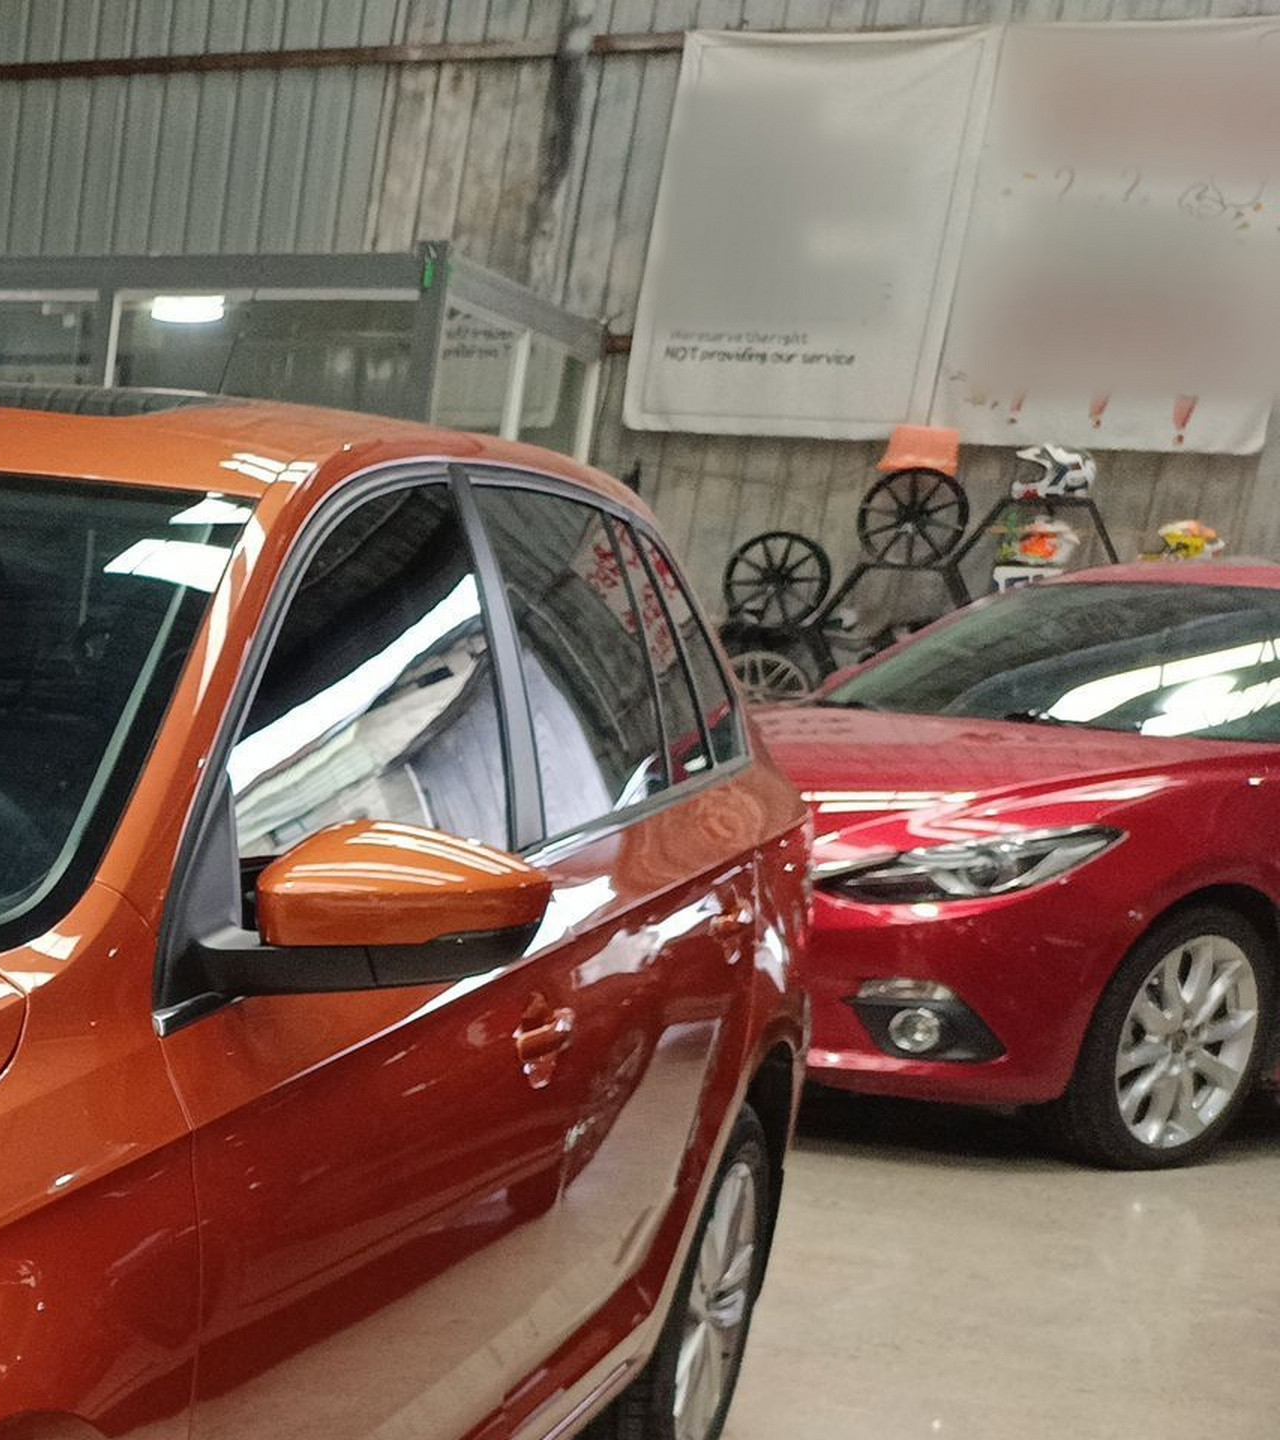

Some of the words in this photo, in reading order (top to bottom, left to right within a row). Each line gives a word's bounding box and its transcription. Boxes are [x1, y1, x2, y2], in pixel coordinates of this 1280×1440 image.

[664, 345, 698, 362] NOT
[770, 351, 797, 364] our
[801, 351, 855, 366] service
